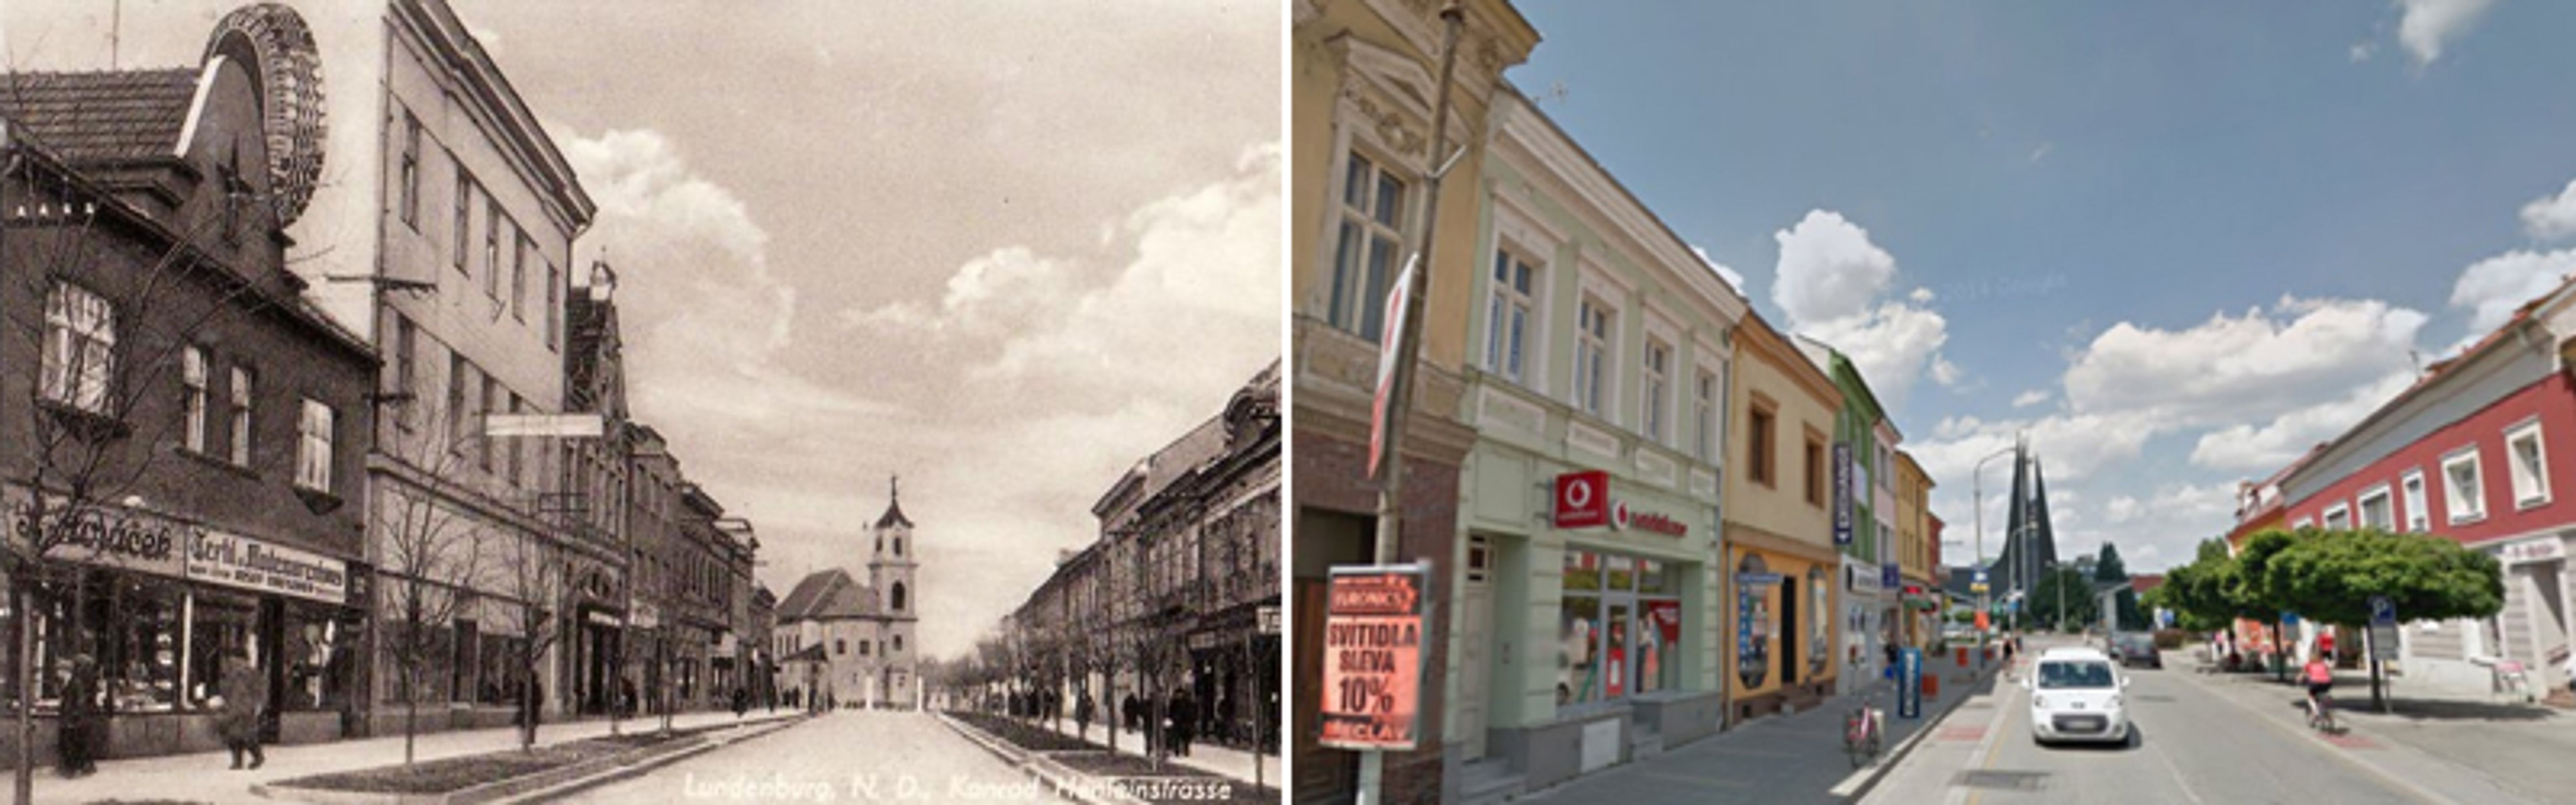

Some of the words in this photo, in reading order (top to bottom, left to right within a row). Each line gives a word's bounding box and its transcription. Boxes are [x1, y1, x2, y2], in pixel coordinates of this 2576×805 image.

[1328, 625, 1417, 646] SVITIDLA
[1339, 650, 1394, 673] SLEVA
[1339, 677, 1394, 713] 10%
